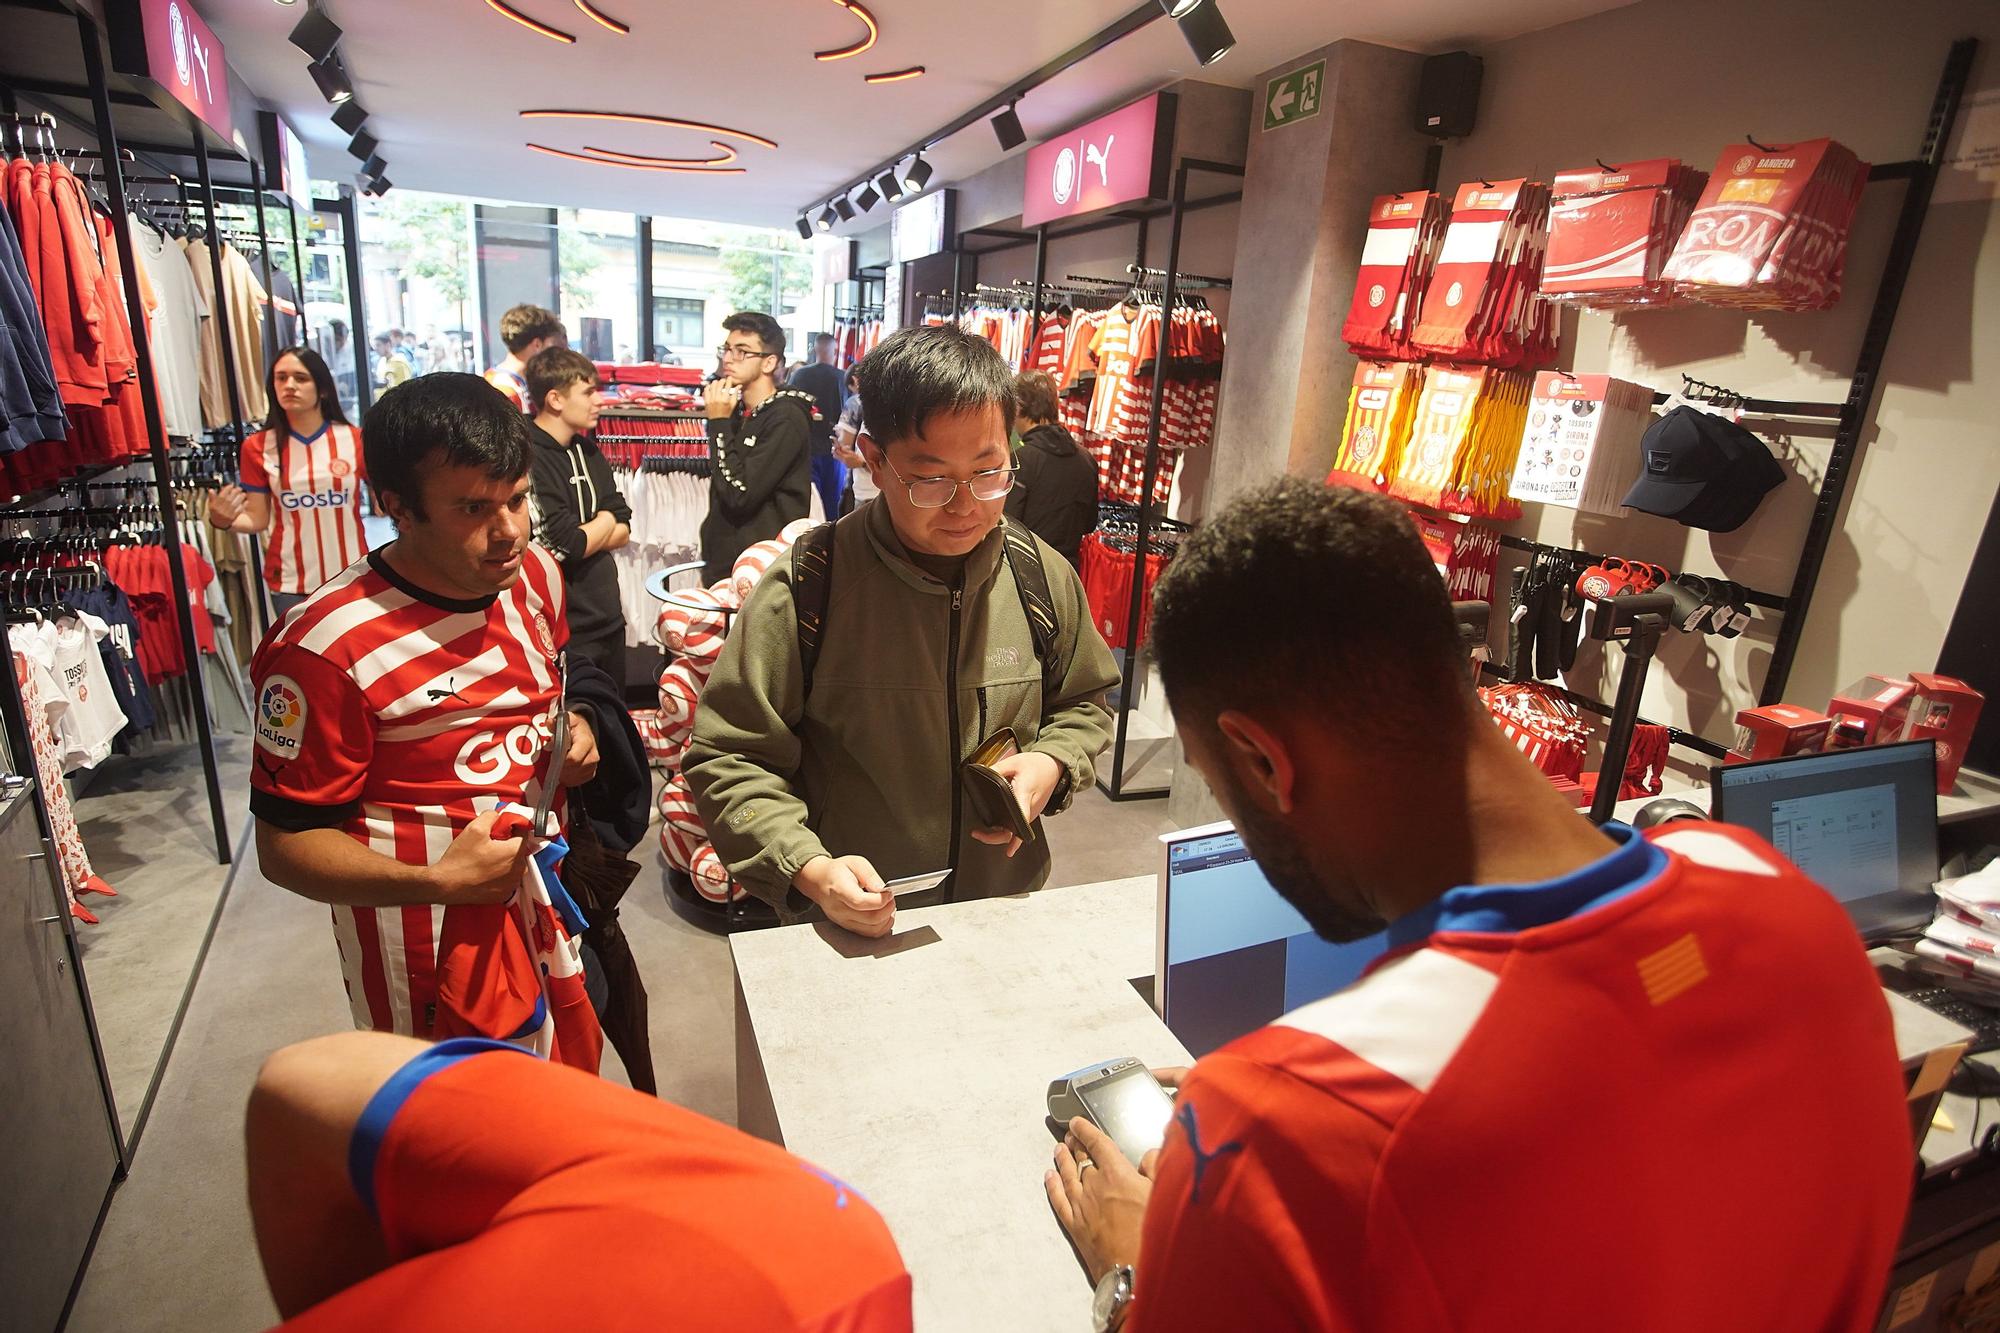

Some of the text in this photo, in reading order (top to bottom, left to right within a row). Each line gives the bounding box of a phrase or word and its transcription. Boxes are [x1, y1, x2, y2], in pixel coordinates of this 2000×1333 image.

[1756, 158, 1796, 169] BANDERA
[1566, 430, 1590, 441] GIRONA
[1515, 480, 1539, 492] GIRONA
[1540, 483, 1550, 494] FC
[281, 488, 349, 509] Gosbi
[259, 723, 296, 748] LaLiga
[454, 713, 553, 785] Gos
